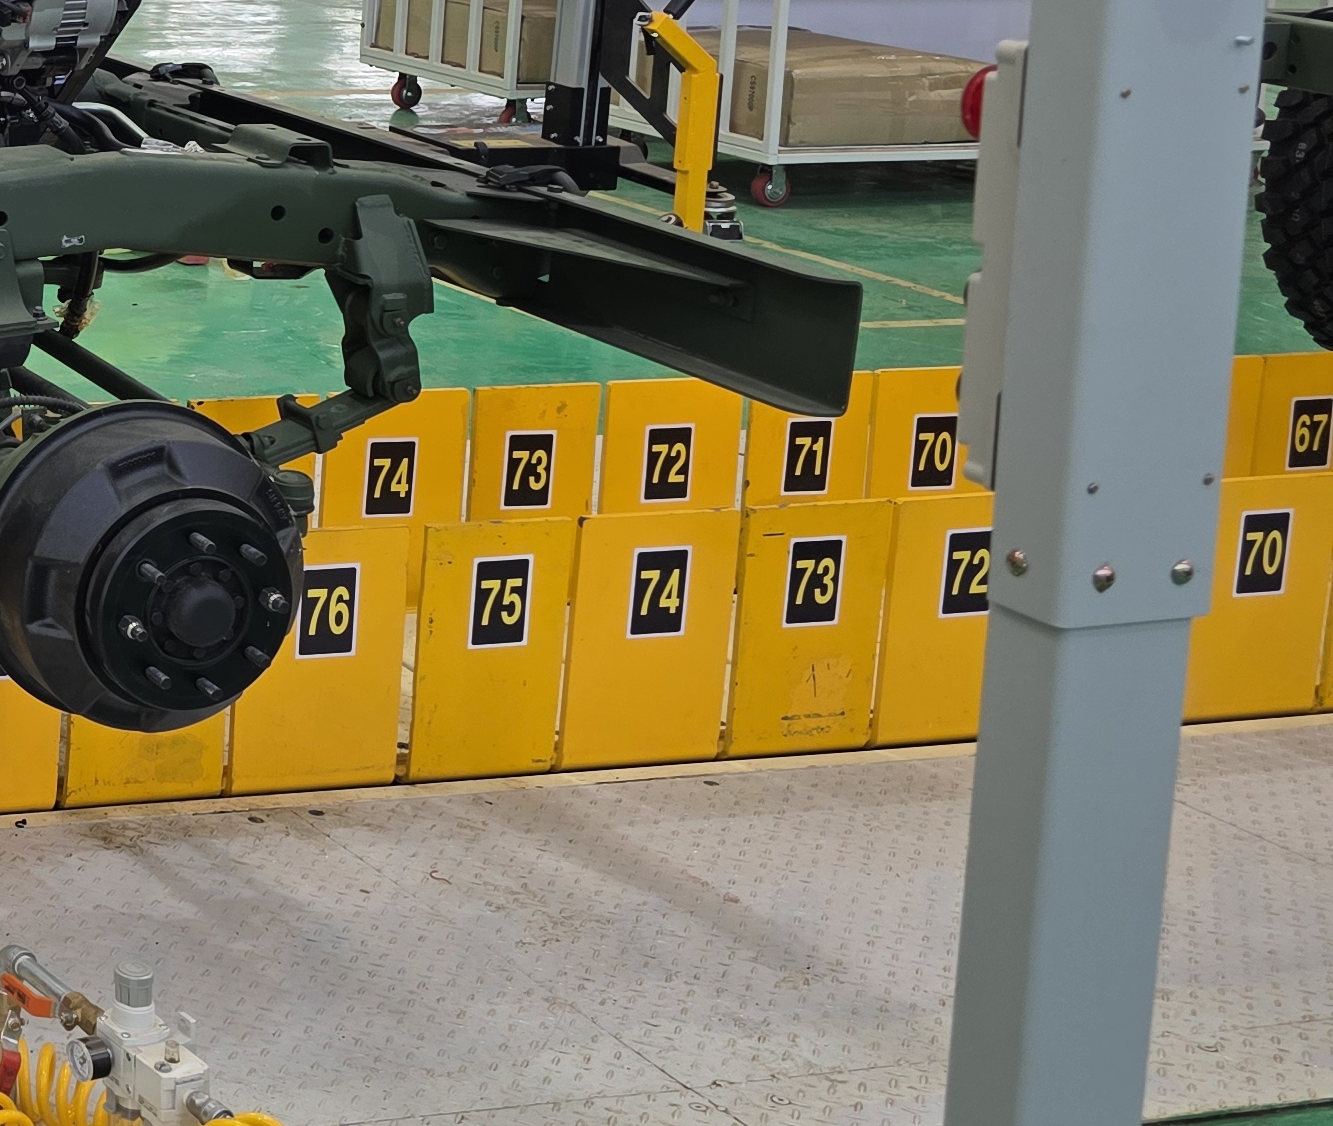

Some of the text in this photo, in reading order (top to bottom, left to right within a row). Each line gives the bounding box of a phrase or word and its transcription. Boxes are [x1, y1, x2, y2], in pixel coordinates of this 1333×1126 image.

[917, 430, 953, 473] 70
[1294, 413, 1329, 453] 67
[373, 457, 409, 499] 74
[512, 449, 548, 491] 73
[651, 442, 687, 484] 72
[794, 436, 824, 476] 71
[952, 549, 988, 595] 72
[1244, 529, 1283, 576] 70
[480, 577, 523, 626] 75
[640, 568, 680, 616] 74
[795, 557, 836, 605] 73
[307, 585, 350, 636] 76
